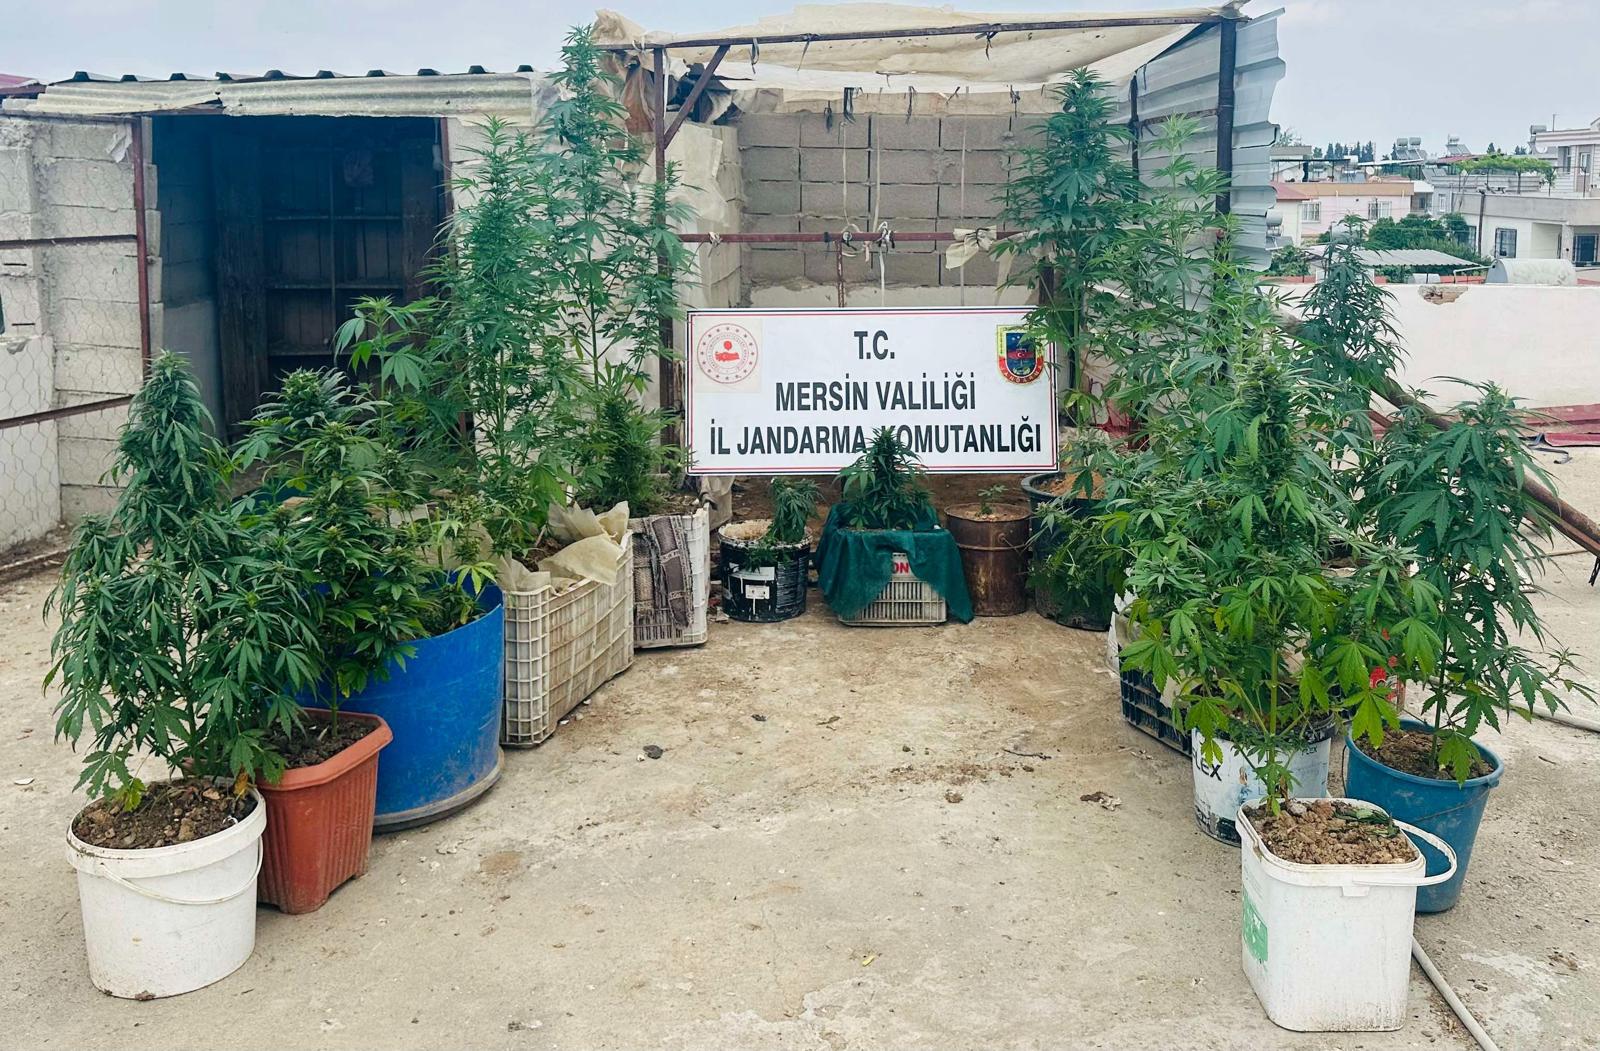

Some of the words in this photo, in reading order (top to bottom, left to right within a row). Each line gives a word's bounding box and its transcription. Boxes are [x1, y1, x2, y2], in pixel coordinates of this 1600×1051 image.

[854, 330, 895, 360] T.C.
[775, 373, 868, 412] MERSİN
[876, 371, 976, 411] VALİLİĞİ
[710, 418, 731, 455] İL
[737, 425, 867, 454] JANDARMA
